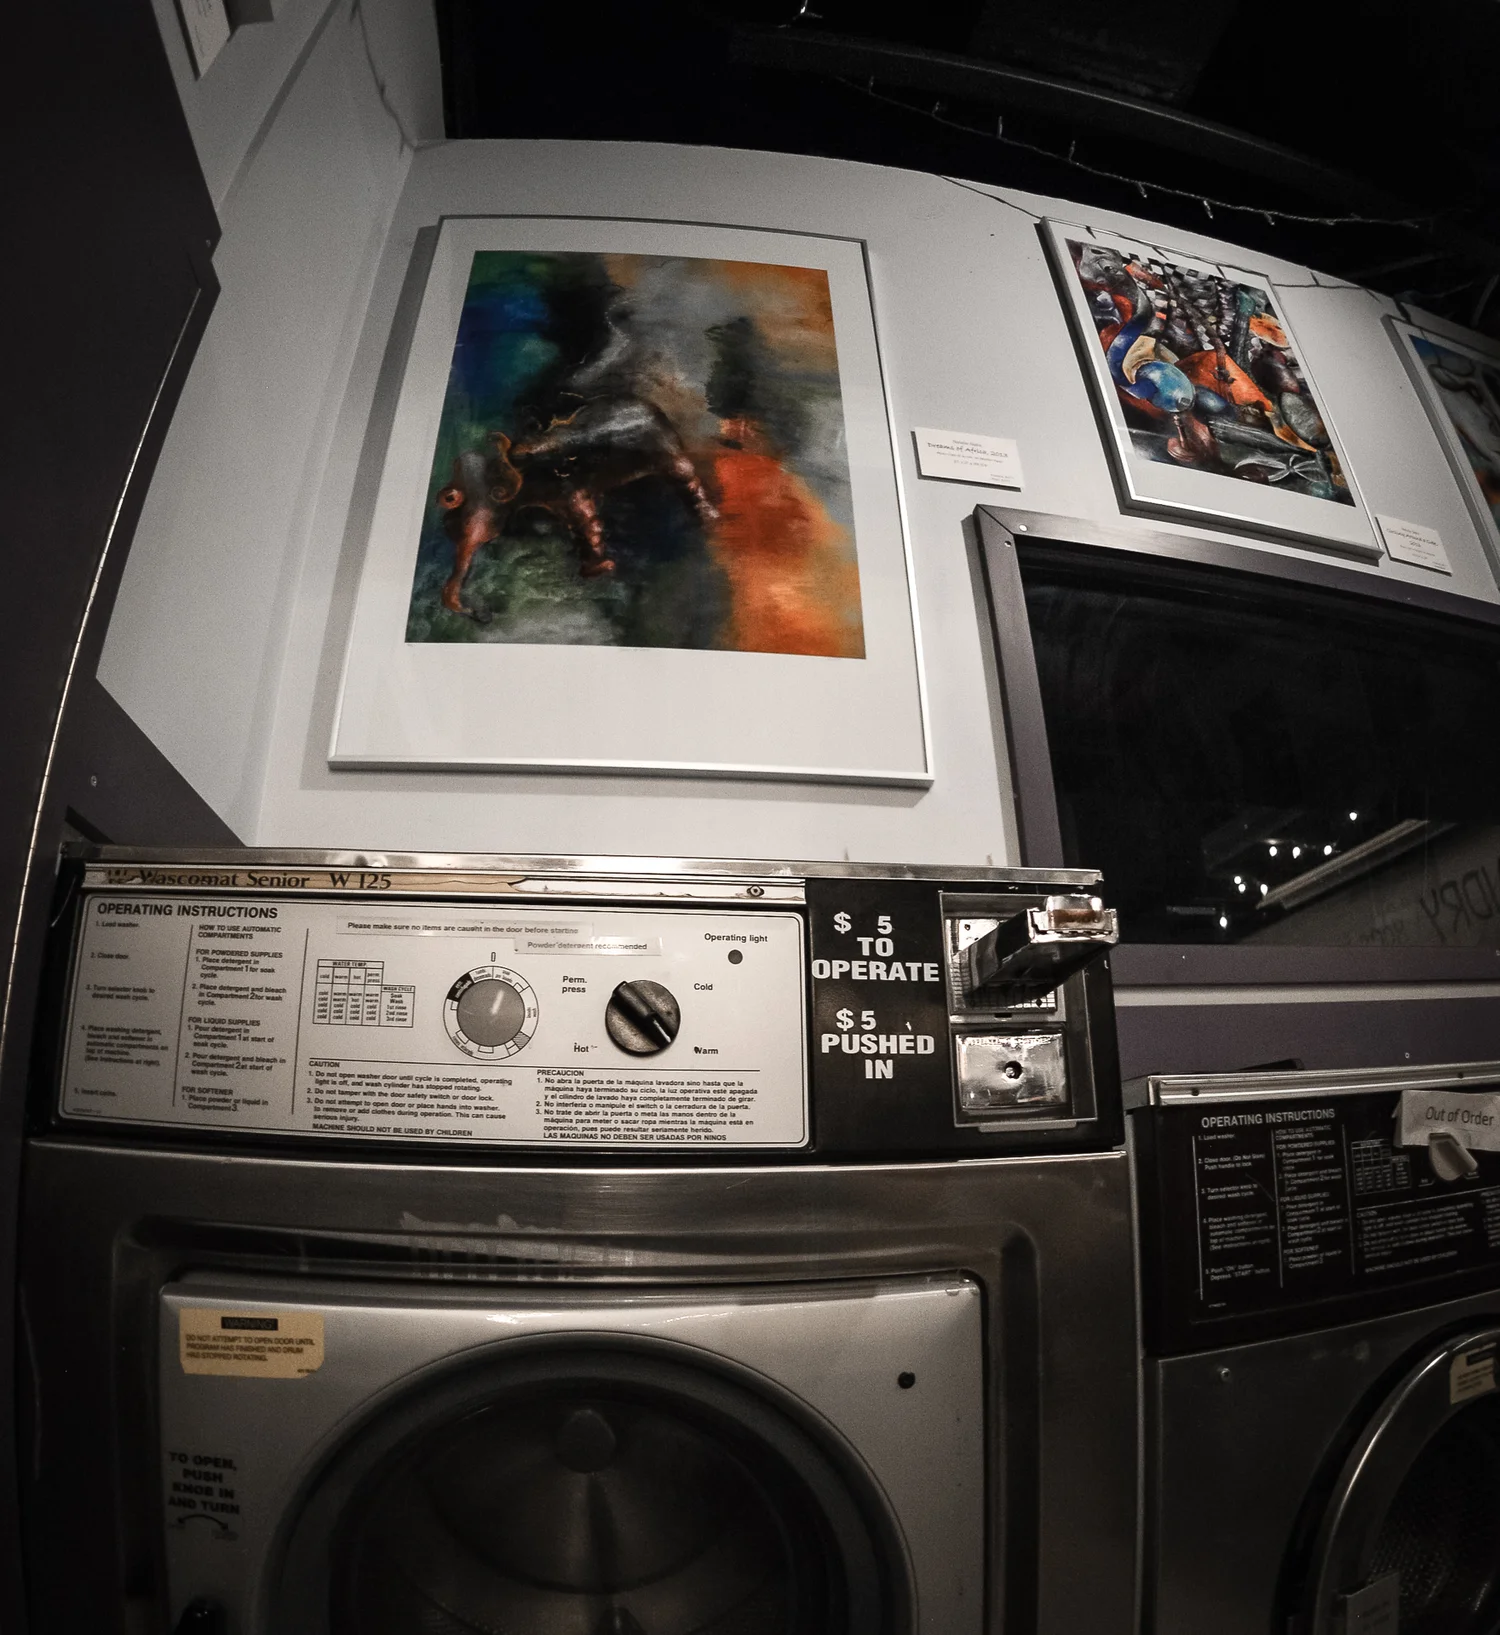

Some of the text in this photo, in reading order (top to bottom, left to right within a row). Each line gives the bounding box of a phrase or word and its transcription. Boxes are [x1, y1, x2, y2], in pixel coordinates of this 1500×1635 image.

[138, 870, 238, 887] Wascomat
[246, 872, 309, 888] Senior
[329, 872, 350, 887] W
[359, 873, 392, 889] 125
[97, 903, 278, 919] OPERATING INSTRUCTIONS
[833, 912, 893, 935] $ 5
[704, 932, 768, 944] Operating light
[857, 937, 894, 957] TO
[811, 959, 940, 982] OPERATE
[562, 975, 713, 991] Perm. Cold
[562, 985, 586, 995] press
[574, 1043, 719, 1055] Hot Warm
[821, 1033, 935, 1055] PUSHED
[865, 1059, 894, 1079] IN
[1201, 1108, 1335, 1128] OPERATING INSTRUCTIONS
[1426, 1106, 1494, 1126] Out of Order
[312, 1123, 345, 1131] MACHINE
[347, 1124, 375, 1132] SHOULD
[169, 1451, 237, 1471] TO OPEN,
[183, 1468, 223, 1483] PUSH
[219, 1488, 234, 1499] IN
[168, 1495, 240, 1515] AND TURN
